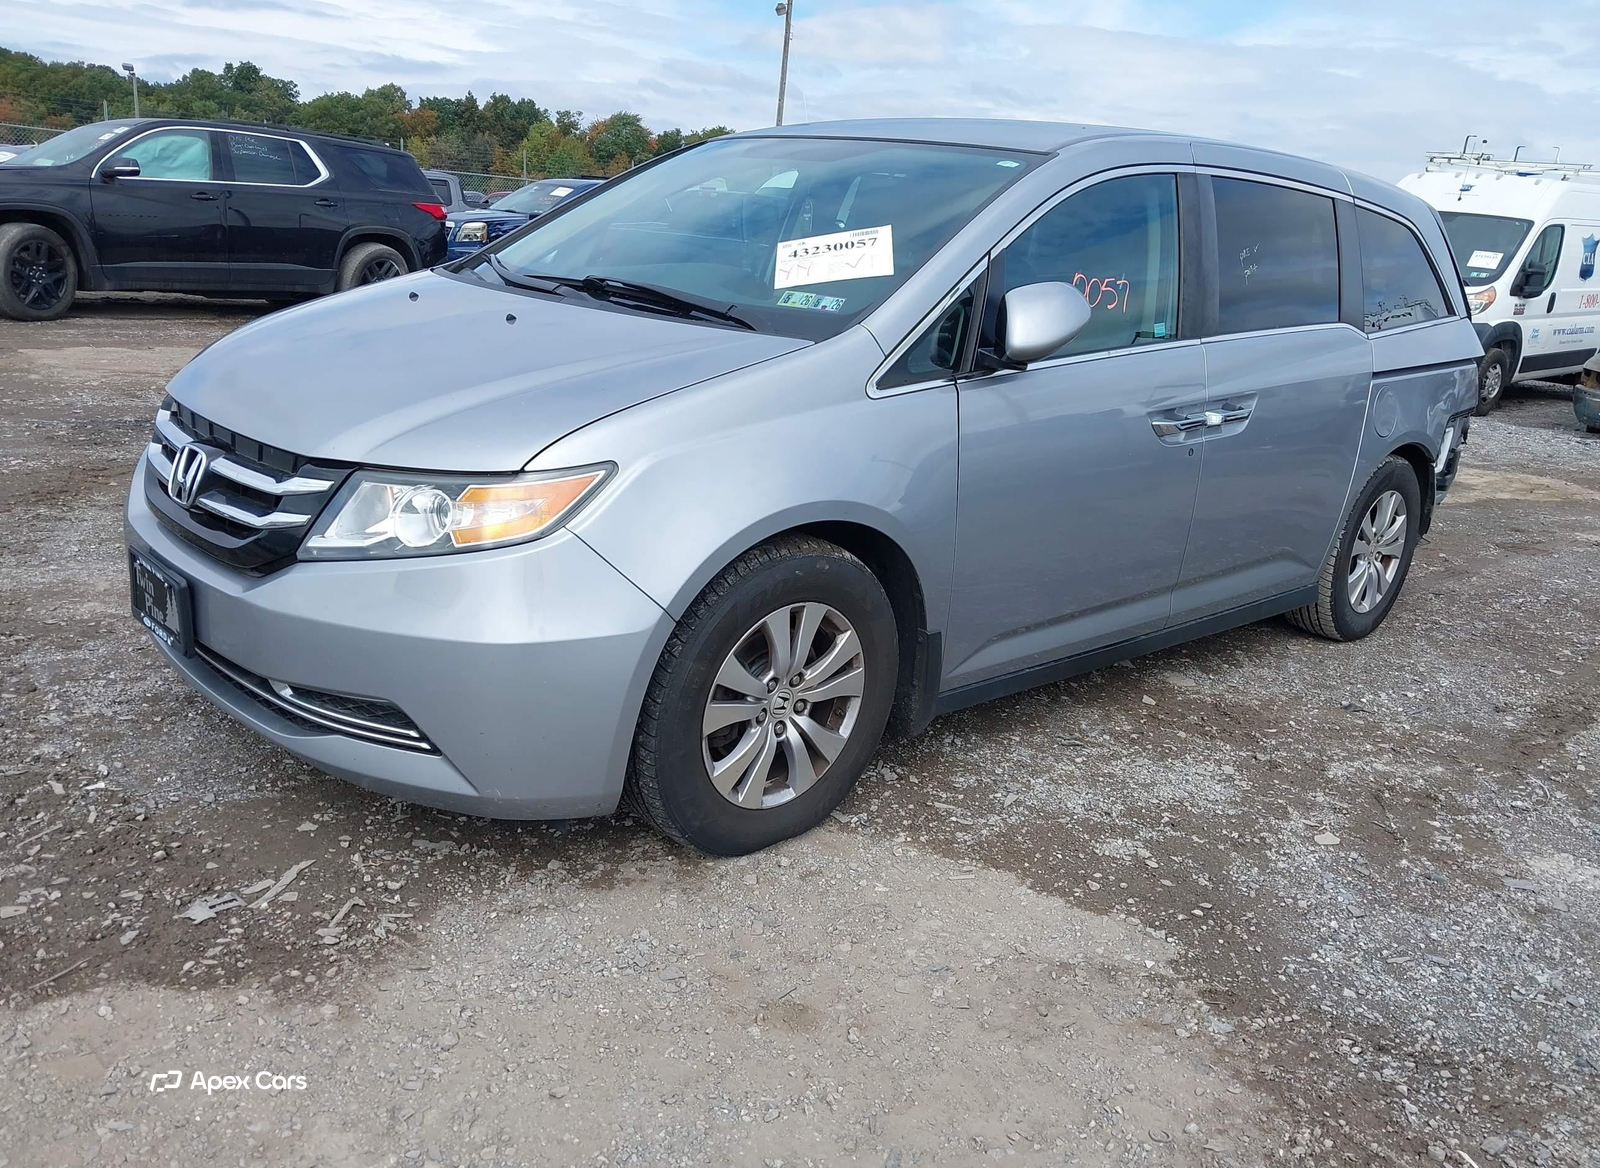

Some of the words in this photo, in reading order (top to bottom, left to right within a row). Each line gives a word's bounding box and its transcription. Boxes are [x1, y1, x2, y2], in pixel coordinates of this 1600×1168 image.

[788, 237, 878, 259] 43230057
[783, 293, 792, 304] 5
[133, 562, 155, 597] Twin
[144, 592, 165, 625] Pine
